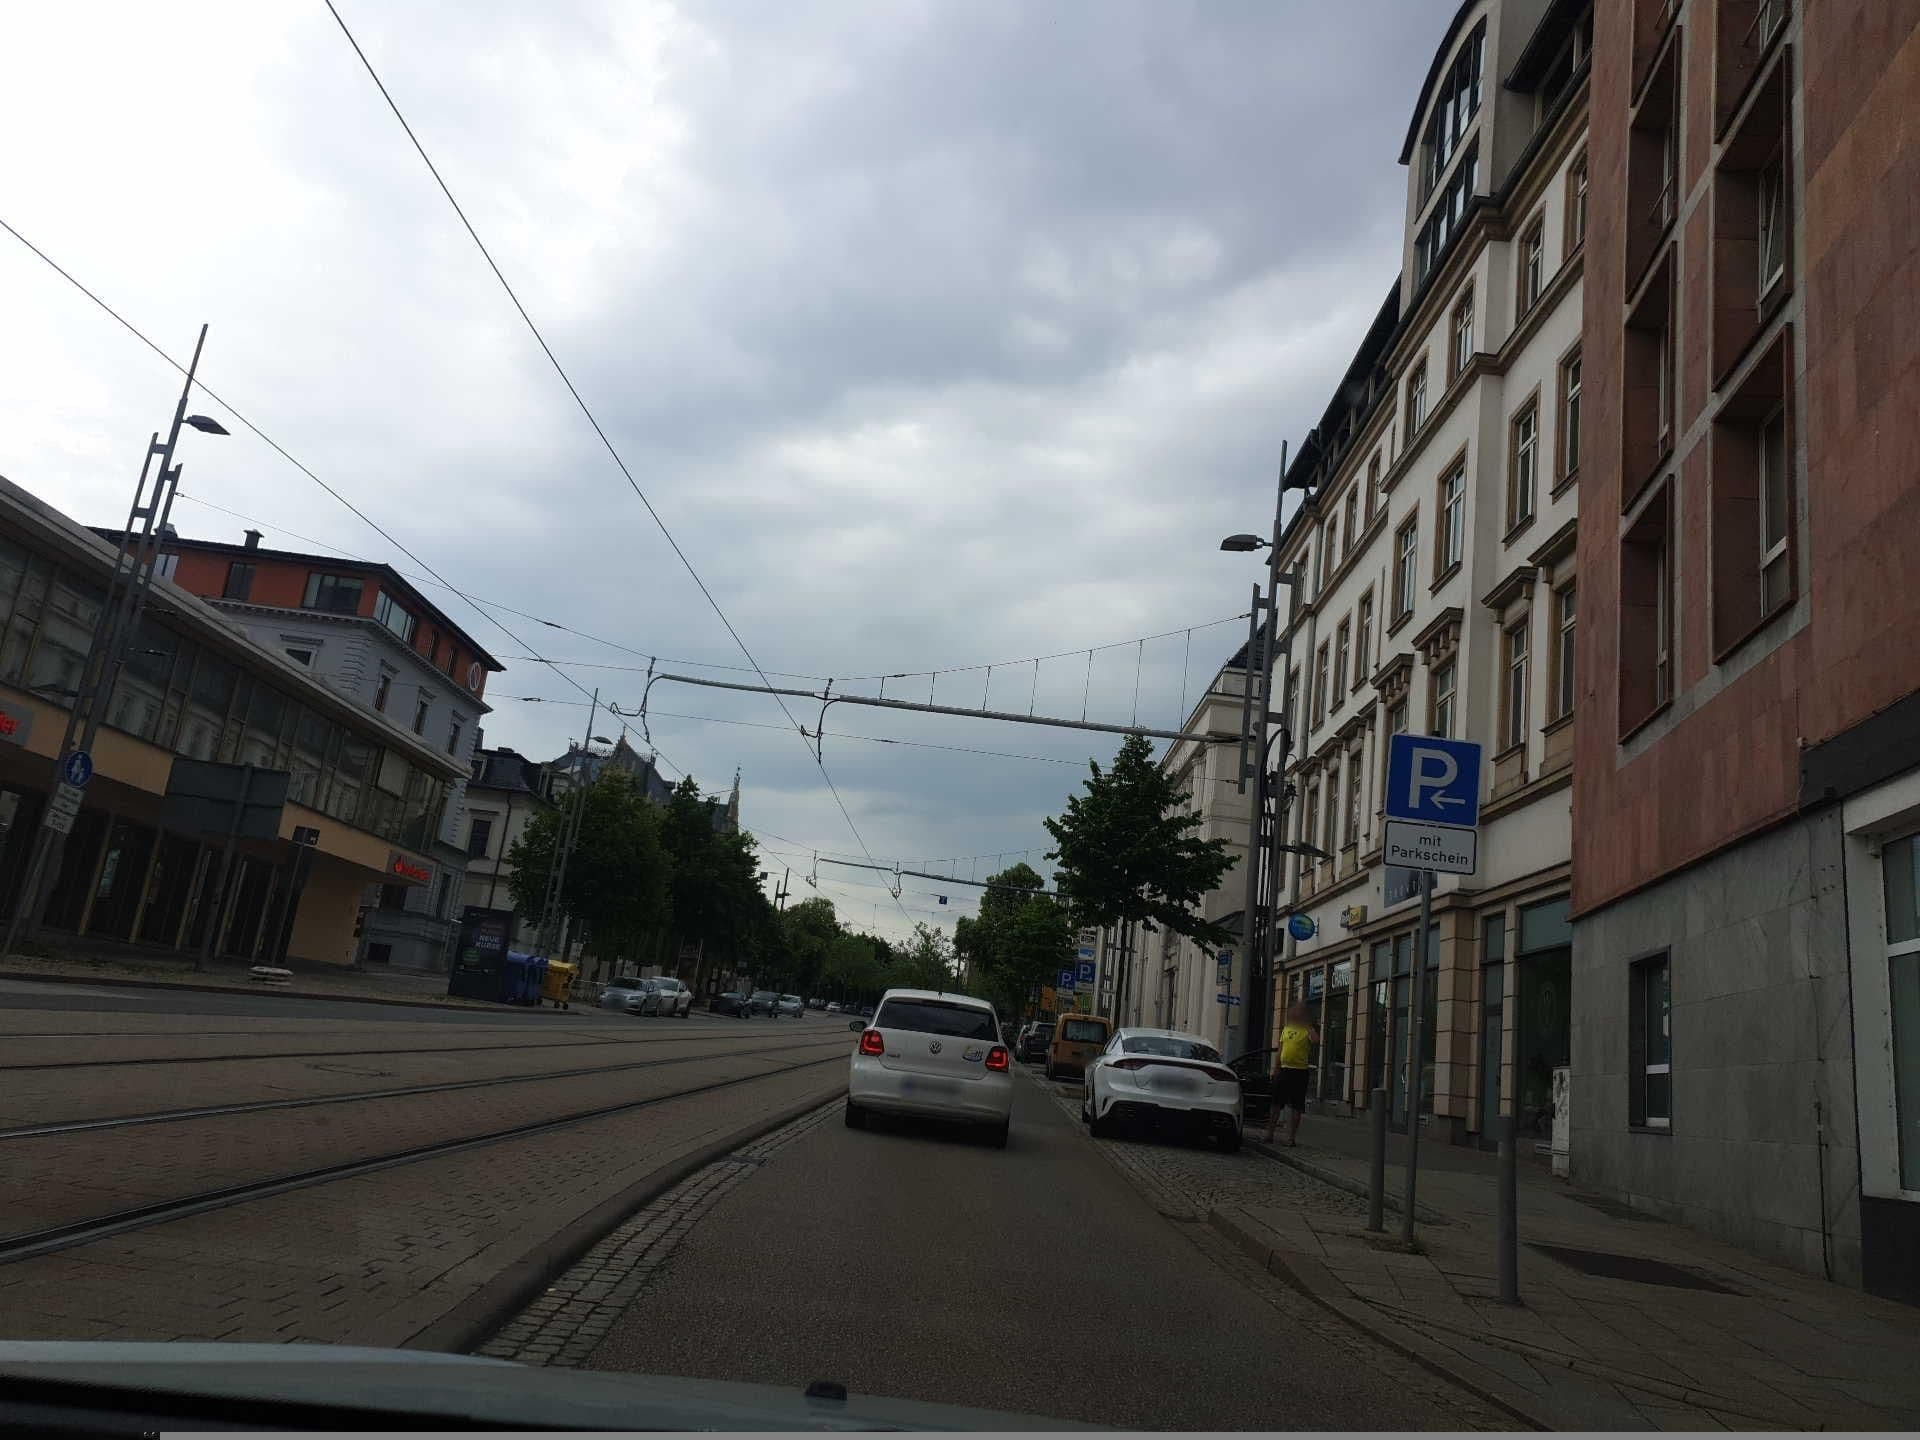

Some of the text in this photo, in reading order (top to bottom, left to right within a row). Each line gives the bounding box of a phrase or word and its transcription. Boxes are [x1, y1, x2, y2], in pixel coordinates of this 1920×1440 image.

[1408, 747, 1458, 809] P
[1419, 835, 1441, 847] mit
[1391, 845, 1468, 865] Parkschein
